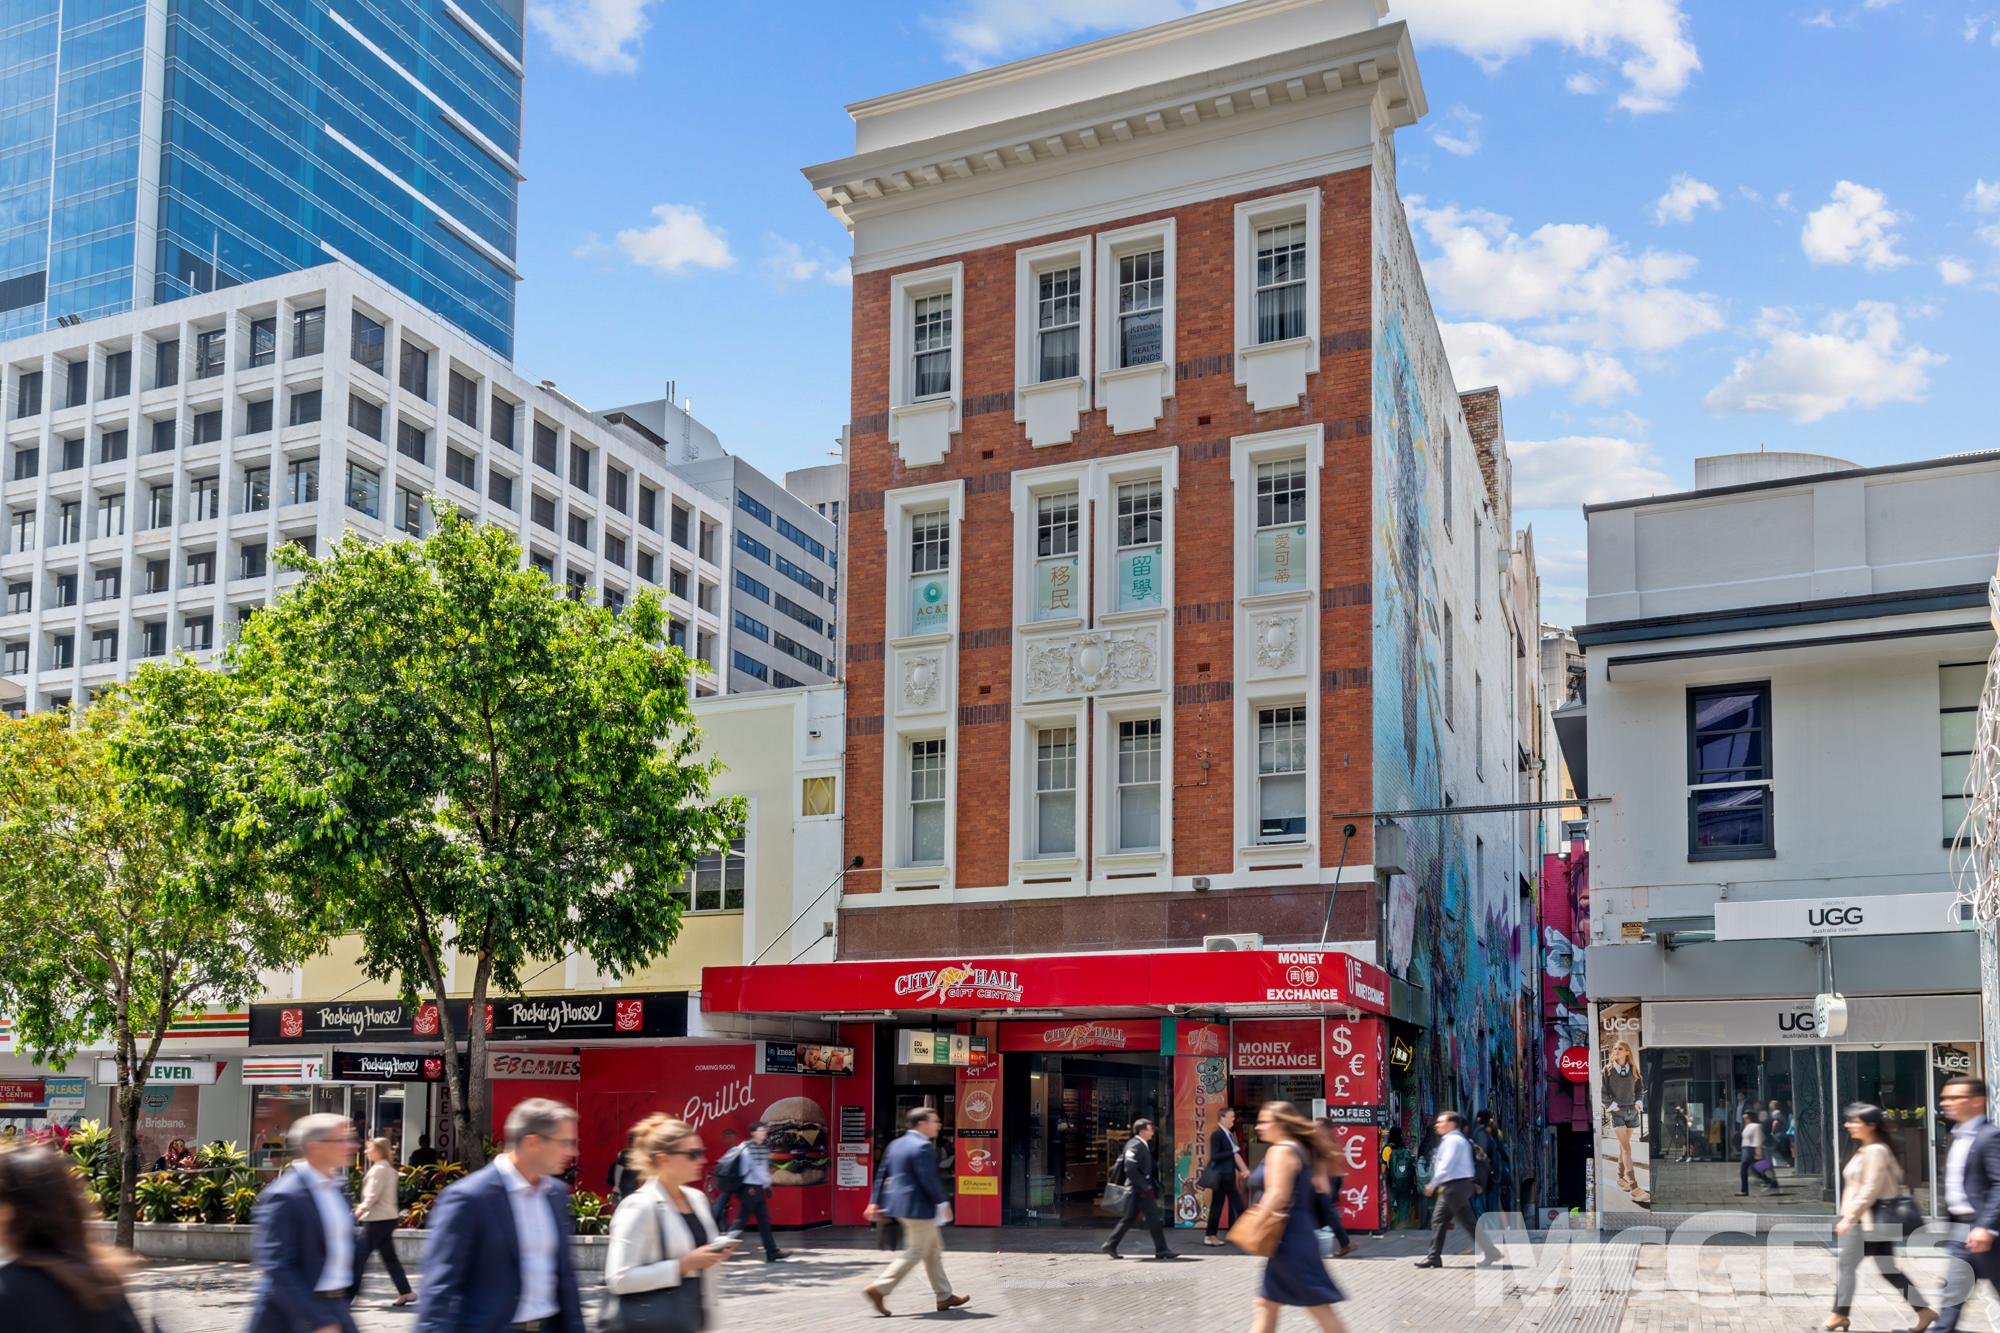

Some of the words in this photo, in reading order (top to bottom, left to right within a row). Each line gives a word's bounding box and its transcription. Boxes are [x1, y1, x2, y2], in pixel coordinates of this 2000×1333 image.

[1132, 344, 1161, 354] HEALTH
[1132, 352, 1161, 364] FUNDS
[1131, 555, 1152, 600] 留學
[1050, 565, 1070, 610] 移民
[1808, 907, 1863, 927] UGG
[1278, 953, 1325, 964] MONEY
[1354, 960, 1362, 979] FEE
[895, 970, 937, 996] CITY
[974, 968, 1023, 994] HALL
[948, 988, 974, 998] GIFT
[977, 989, 1022, 1003] CENTRE
[1266, 989, 1338, 1001] EXCHANGE
[1355, 981, 1368, 1002] MONEY
[1367, 985, 1385, 1007] EXCHANGE
[560, 1000, 603, 1024] Horse
[317, 1008, 364, 1036] Rocking
[363, 1006, 402, 1028] Horse
[1603, 1018, 1640, 1031] UGG
[1778, 1012, 1816, 1031] UG
[1043, 1027, 1071, 1043] CITY
[1095, 1026, 1126, 1042] HALL
[776, 1047, 796, 1056] knead
[1238, 1042, 1291, 1054] MONEY
[358, 1057, 394, 1078] Rocking
[392, 1057, 418, 1072] Horse
[1238, 1055, 1317, 1066] EXCHANGE
[1937, 1056, 1971, 1068] UGG
[56, 1084, 82, 1095] LEASE
[677, 1074, 756, 1133] Grill'd
[1330, 1108, 1345, 1117] NO
[1346, 1108, 1371, 1117] FEES
[145, 1117, 186, 1128] Brisbane.
